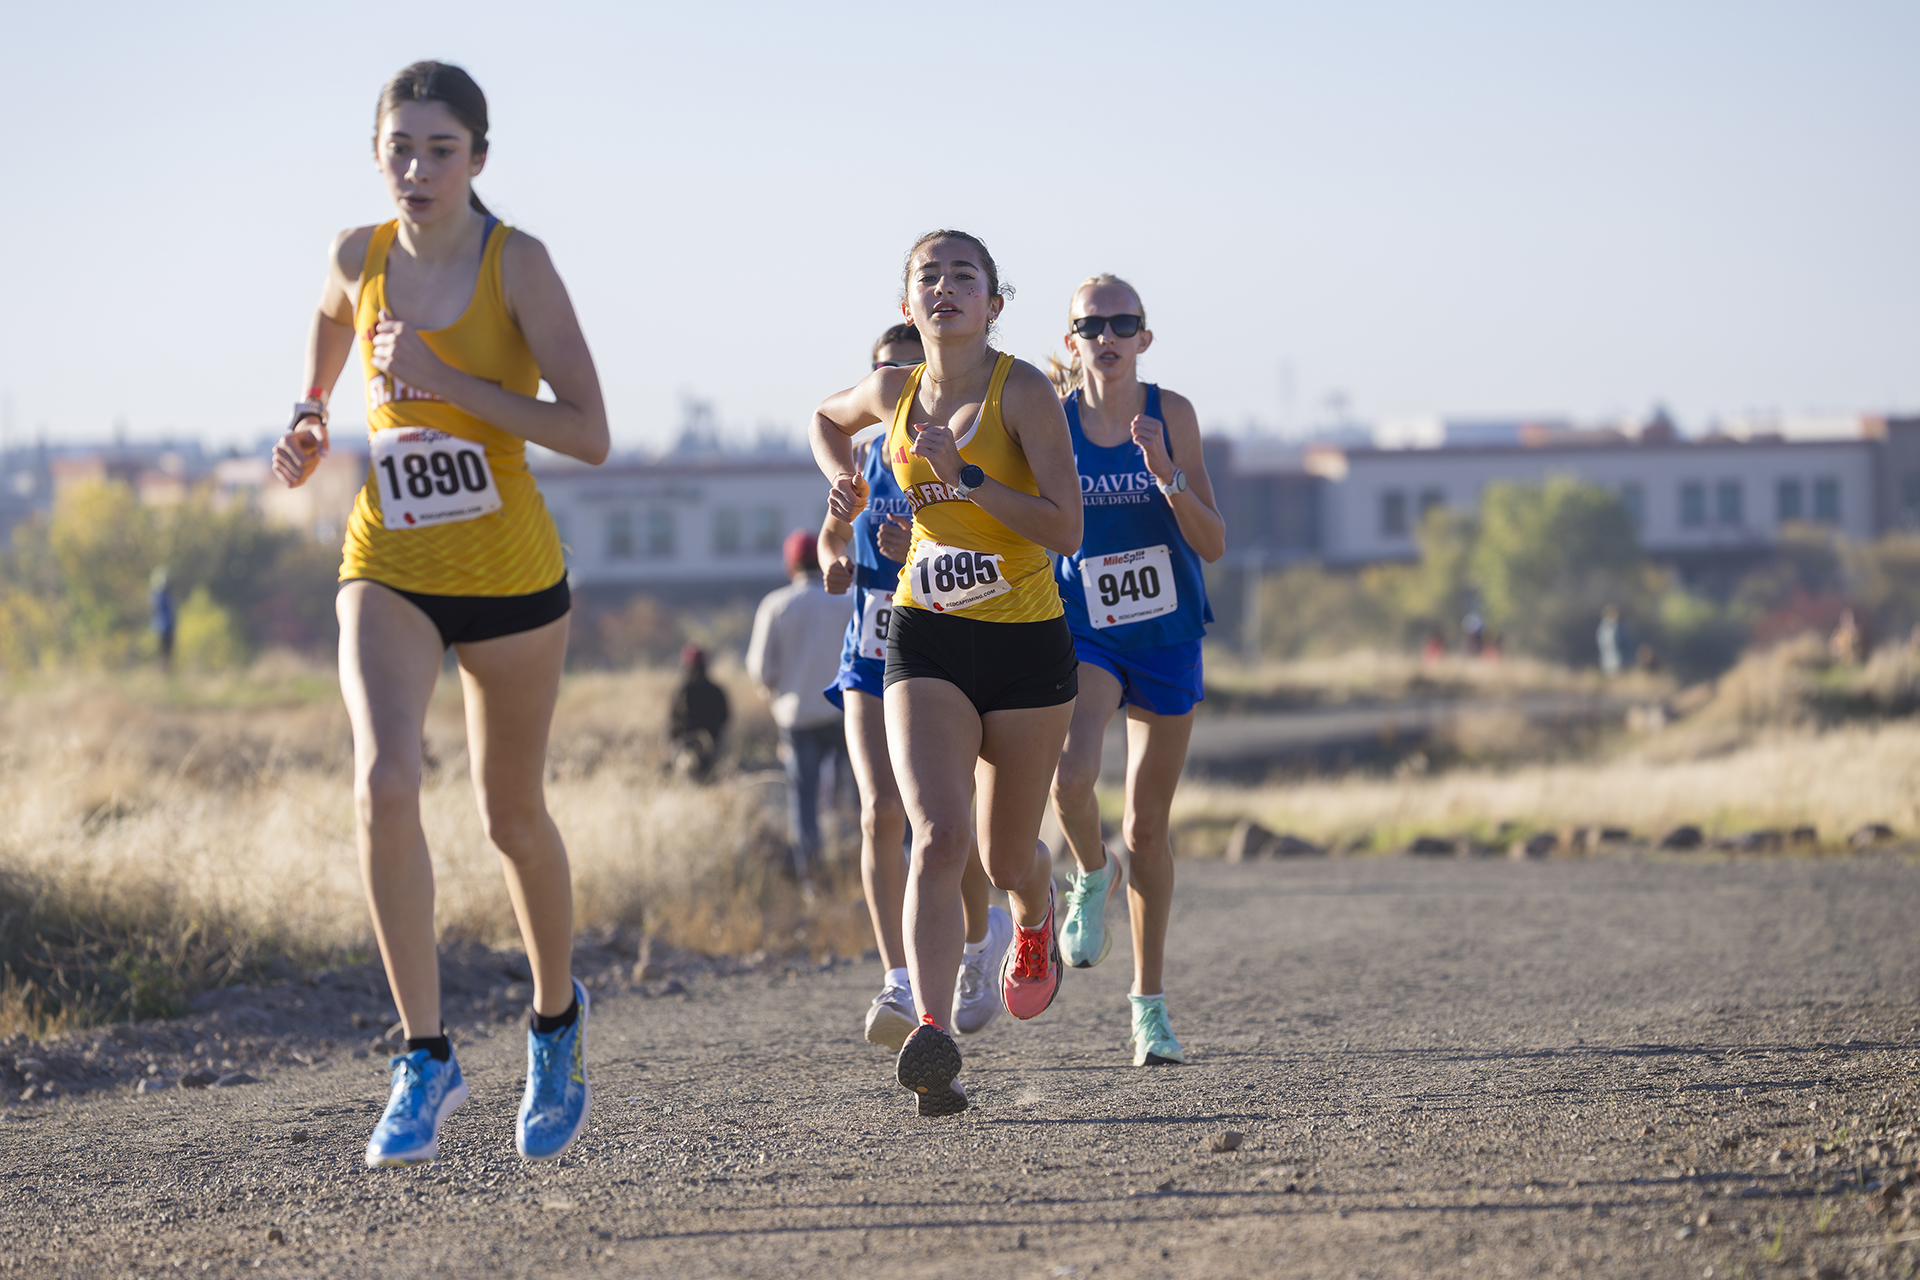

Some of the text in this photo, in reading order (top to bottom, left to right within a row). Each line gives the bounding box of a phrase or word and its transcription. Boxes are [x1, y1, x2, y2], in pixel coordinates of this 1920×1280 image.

[380, 449, 488, 501] 1890
[1079, 471, 1149, 493] DAVIS
[920, 483, 968, 503] FRA
[1082, 493, 1151, 506] LUE DEVILS
[871, 497, 911, 513] DAVI
[915, 551, 998, 595] 1895
[1098, 566, 1161, 607] 940
[946, 588, 996, 607] REDCAPTIMING.COM
